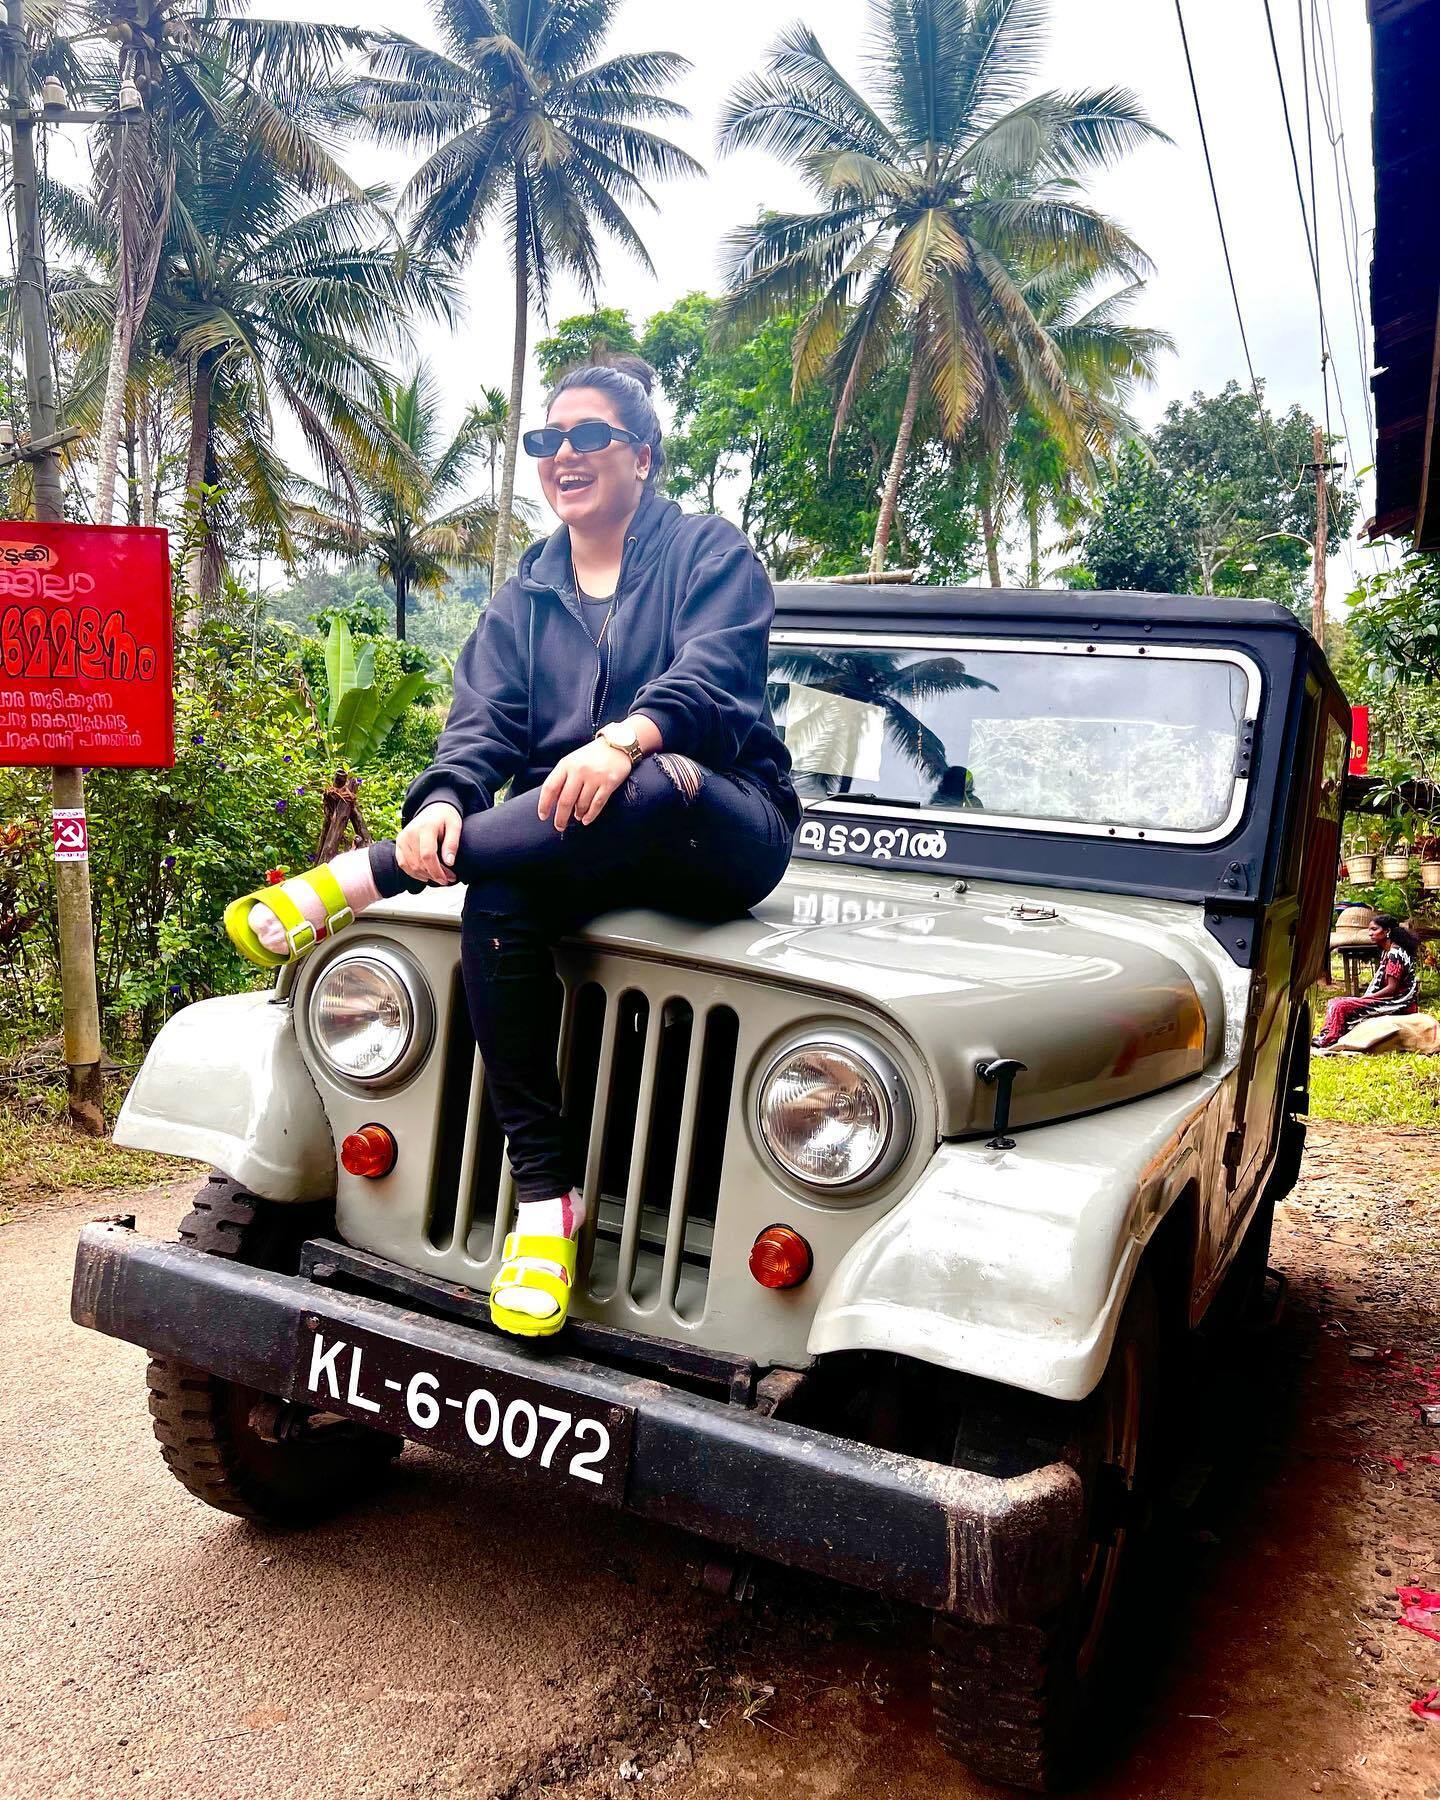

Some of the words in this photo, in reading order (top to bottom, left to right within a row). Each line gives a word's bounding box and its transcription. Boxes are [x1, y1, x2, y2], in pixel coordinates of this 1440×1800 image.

[0, 544, 50, 566] ടുക്കി
[0, 604, 157, 682] മ്മേളനം
[307, 1333, 611, 1485] KL-6-0072
